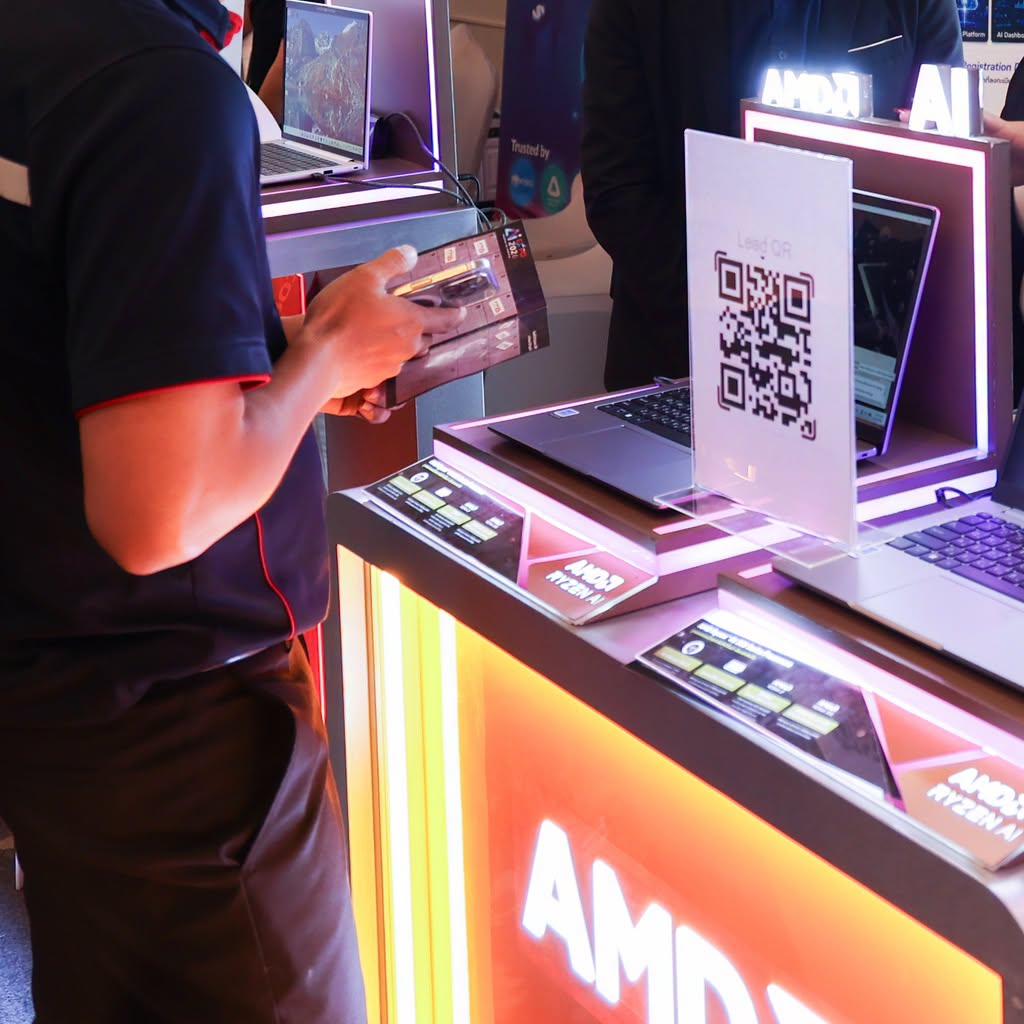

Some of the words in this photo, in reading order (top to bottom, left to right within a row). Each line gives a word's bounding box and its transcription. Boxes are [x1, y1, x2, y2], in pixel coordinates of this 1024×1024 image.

[909, 63, 977, 138] AI
[511, 139, 537, 156] Trusted
[537, 145, 550, 160] by
[545, 569, 594, 600] RYZEN
[585, 593, 605, 605] AI
[927, 782, 1004, 831] RYZEN
[995, 823, 1024, 842] AI
[520, 818, 759, 1024] AMD
